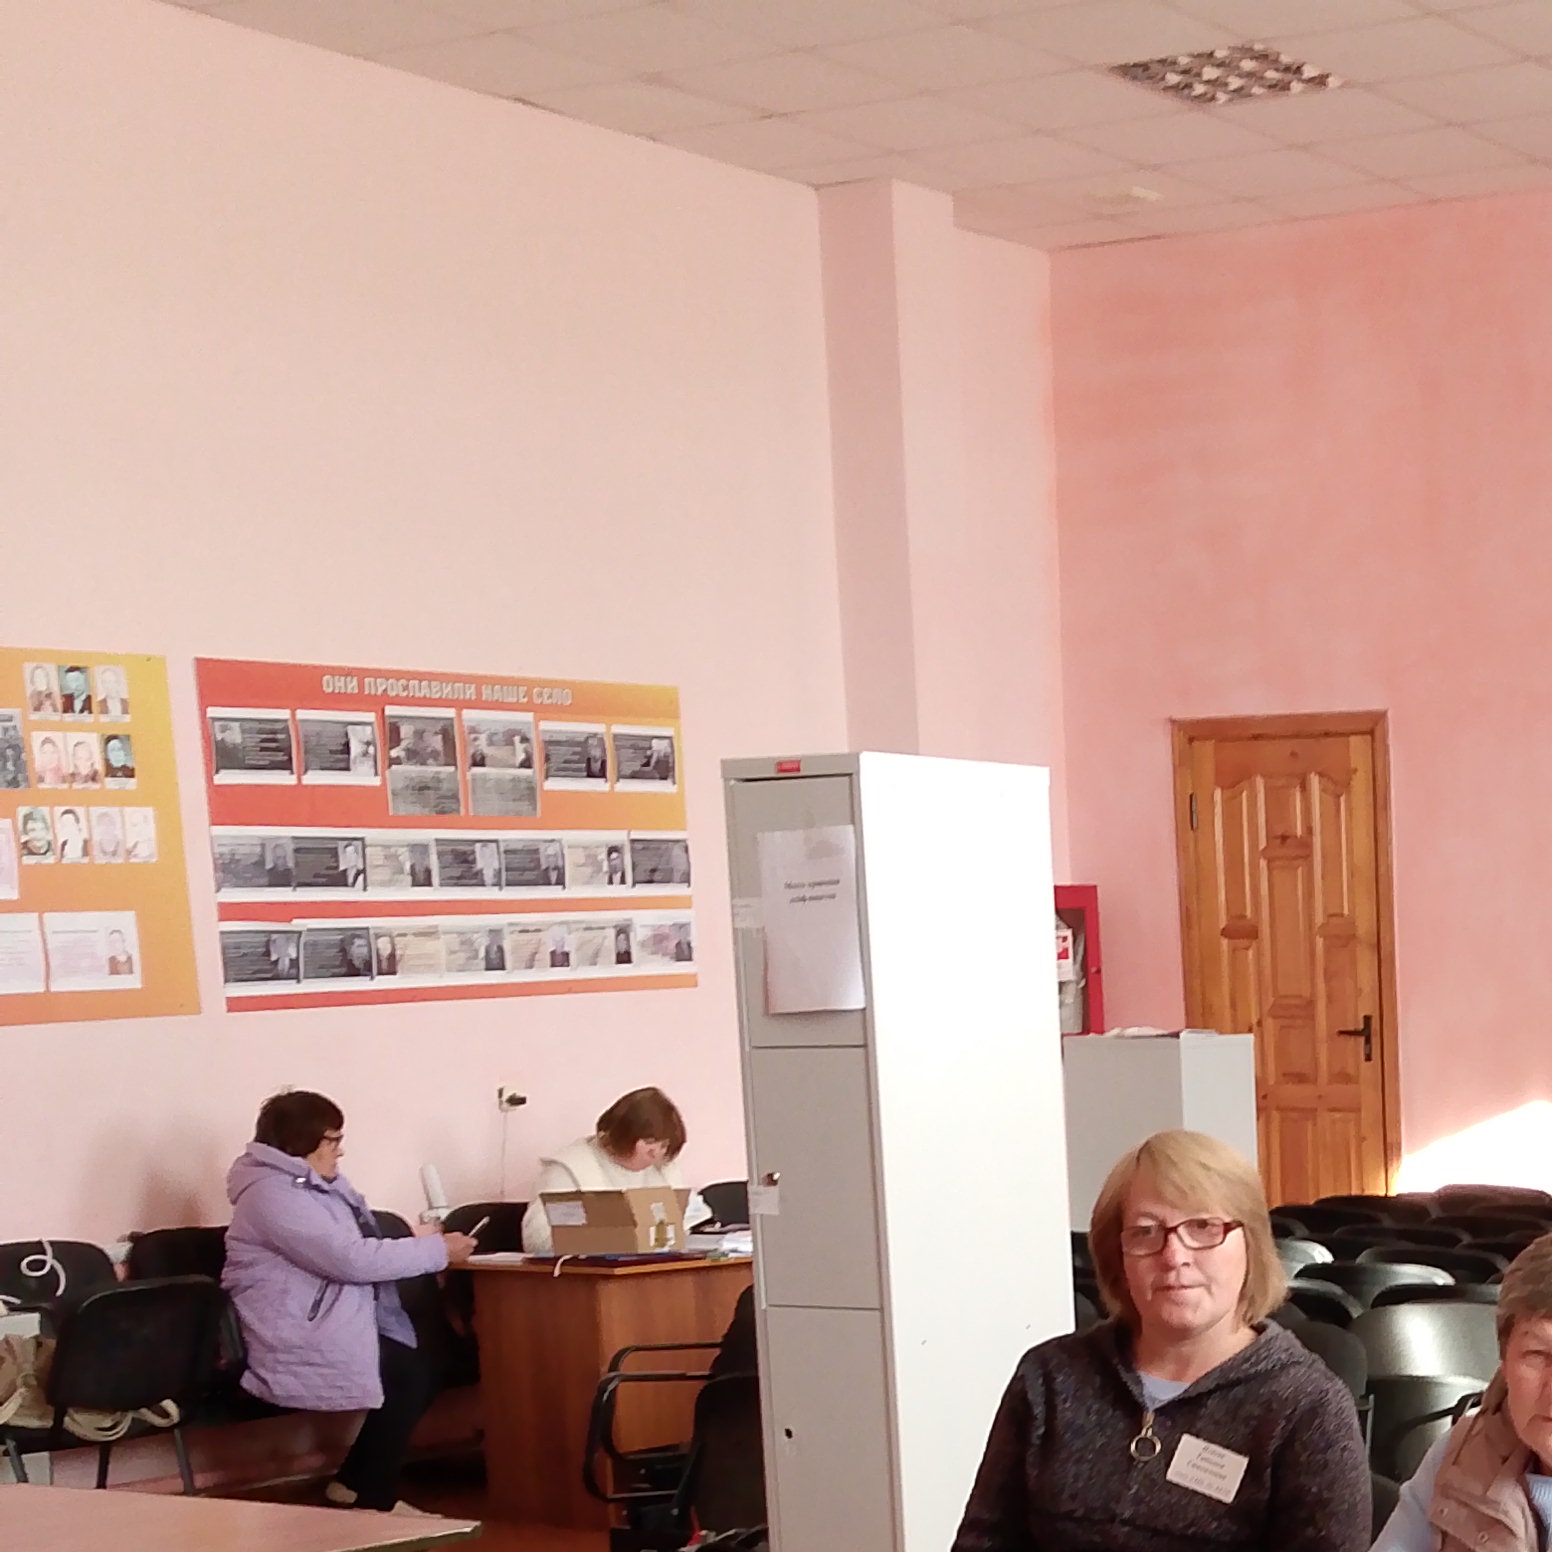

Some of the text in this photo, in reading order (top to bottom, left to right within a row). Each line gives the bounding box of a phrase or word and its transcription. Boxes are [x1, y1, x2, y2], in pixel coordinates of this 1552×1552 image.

[322, 674, 573, 706] ОНИ ПРОСЛАВИЛИ НАШЕ СЕЛО
